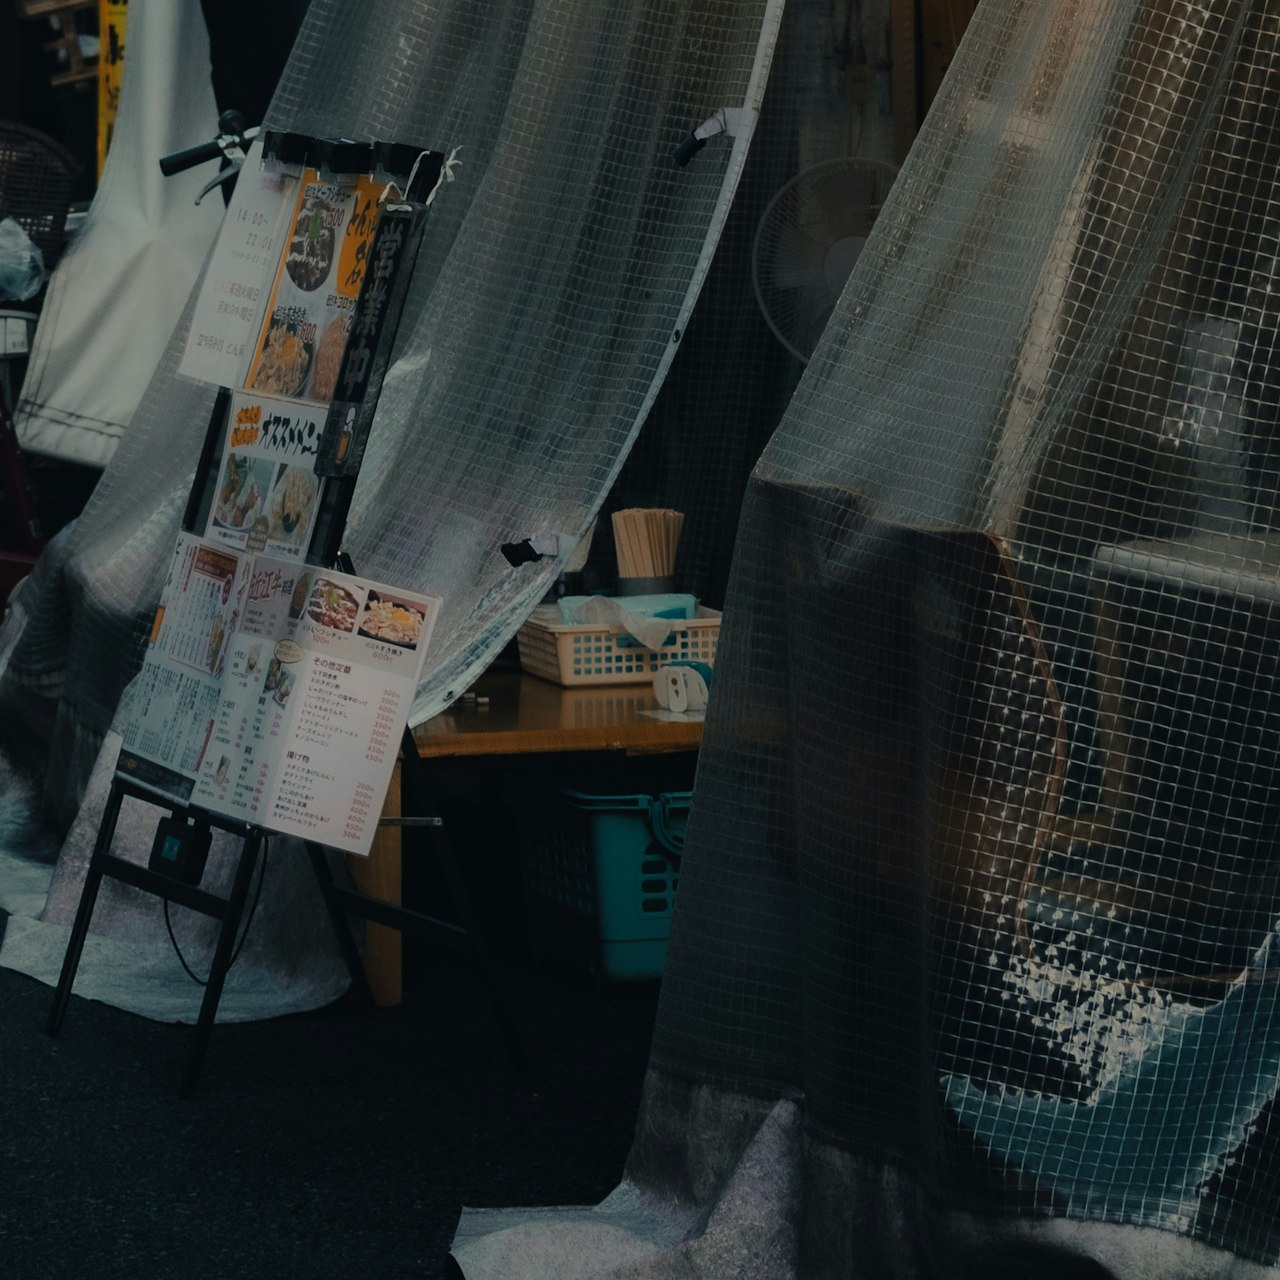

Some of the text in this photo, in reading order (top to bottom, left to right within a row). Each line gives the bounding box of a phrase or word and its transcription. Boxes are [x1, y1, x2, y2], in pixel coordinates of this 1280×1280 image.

[342, 221, 405, 400] 営業中
[249, 568, 282, 602] 近江牛
